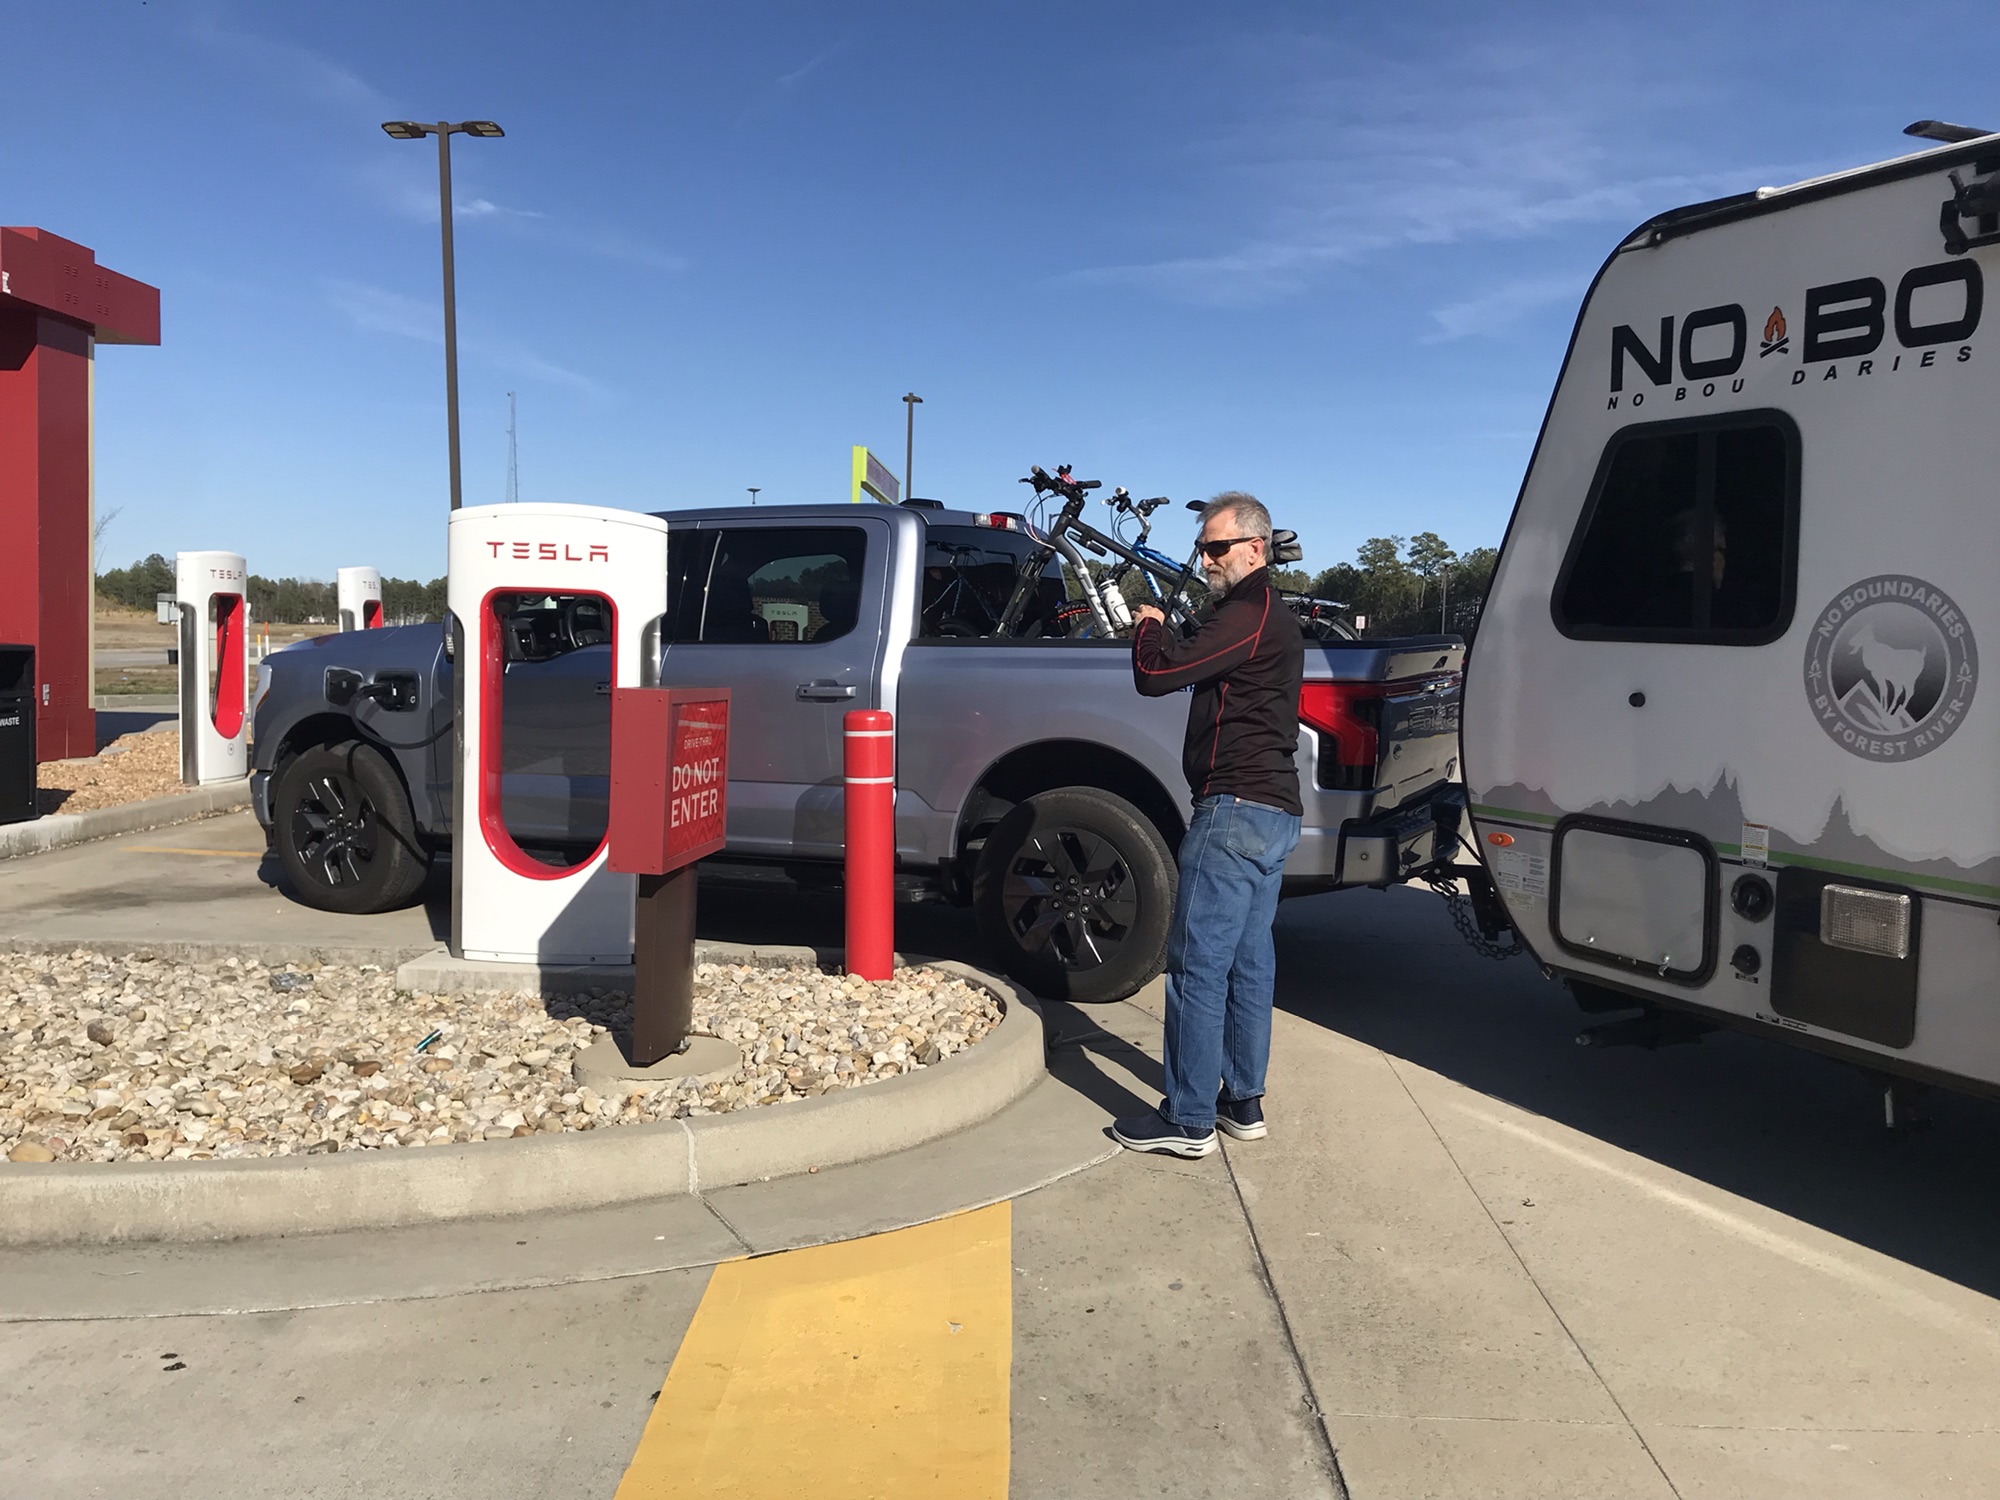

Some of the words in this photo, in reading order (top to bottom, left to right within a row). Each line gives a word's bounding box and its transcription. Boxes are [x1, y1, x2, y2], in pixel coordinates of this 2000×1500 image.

[1610, 303, 1747, 393] NO
[1802, 257, 1984, 364] BO
[1607, 393, 1644, 410] NO
[486, 541, 609, 562] TESLA
[1818, 607, 1842, 638] NO
[1839, 580, 1965, 638] BOUNDARIES
[1815, 694, 1836, 720] BY
[1832, 721, 1908, 756] FOREST
[1914, 698, 1965, 748] RIVER
[672, 763, 691, 792] DO
[694, 757, 719, 787] NOT
[671, 788, 718, 828] ENTER
